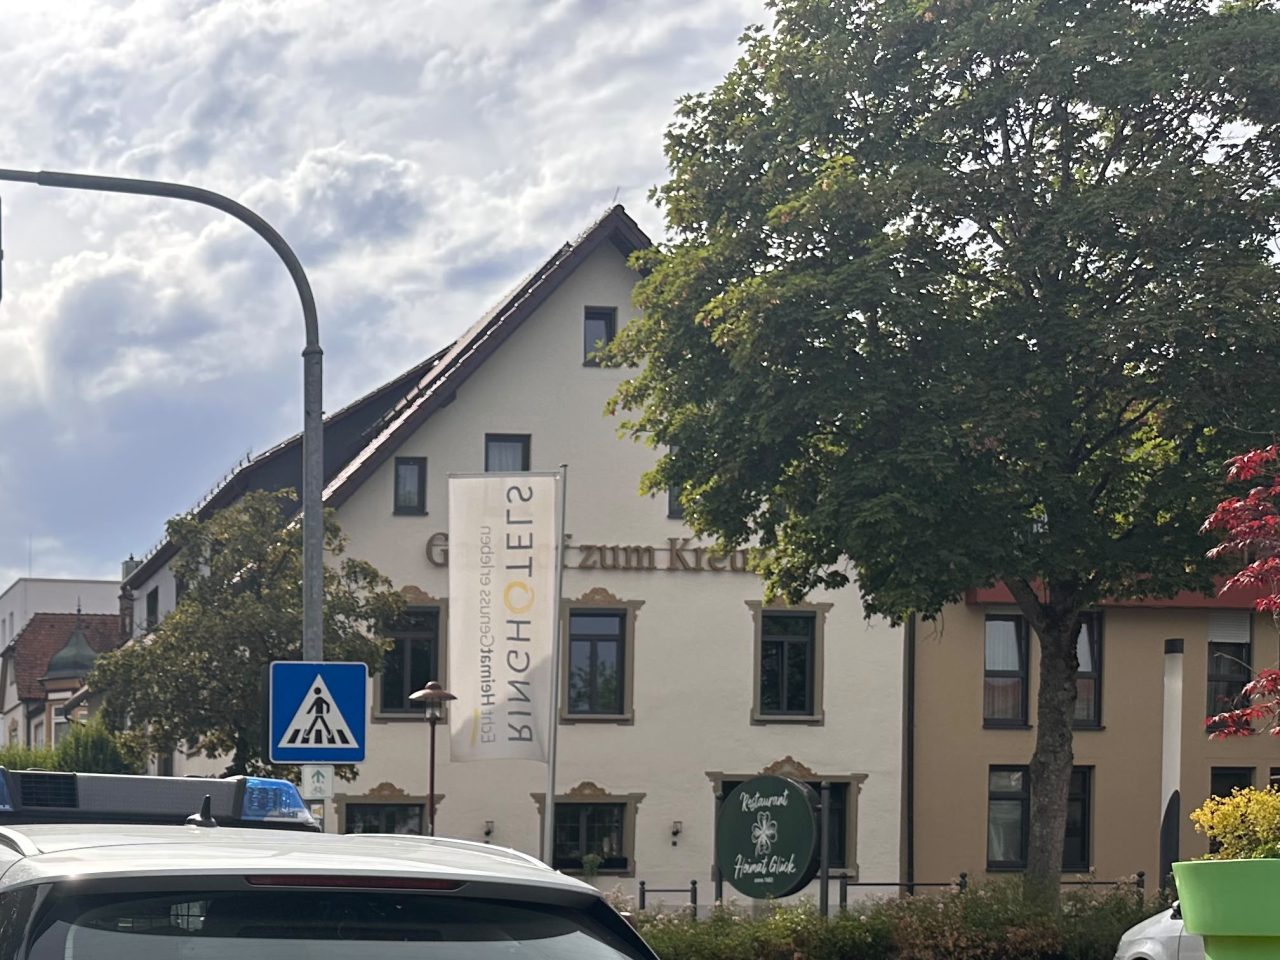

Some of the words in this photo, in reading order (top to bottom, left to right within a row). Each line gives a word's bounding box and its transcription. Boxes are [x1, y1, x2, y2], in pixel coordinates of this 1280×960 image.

[578, 543, 657, 571] zum
[665, 537, 760, 573] Kreu
[739, 788, 789, 812] Restaurant
[734, 853, 768, 880] Heimat
[769, 853, 797, 875] Glück
